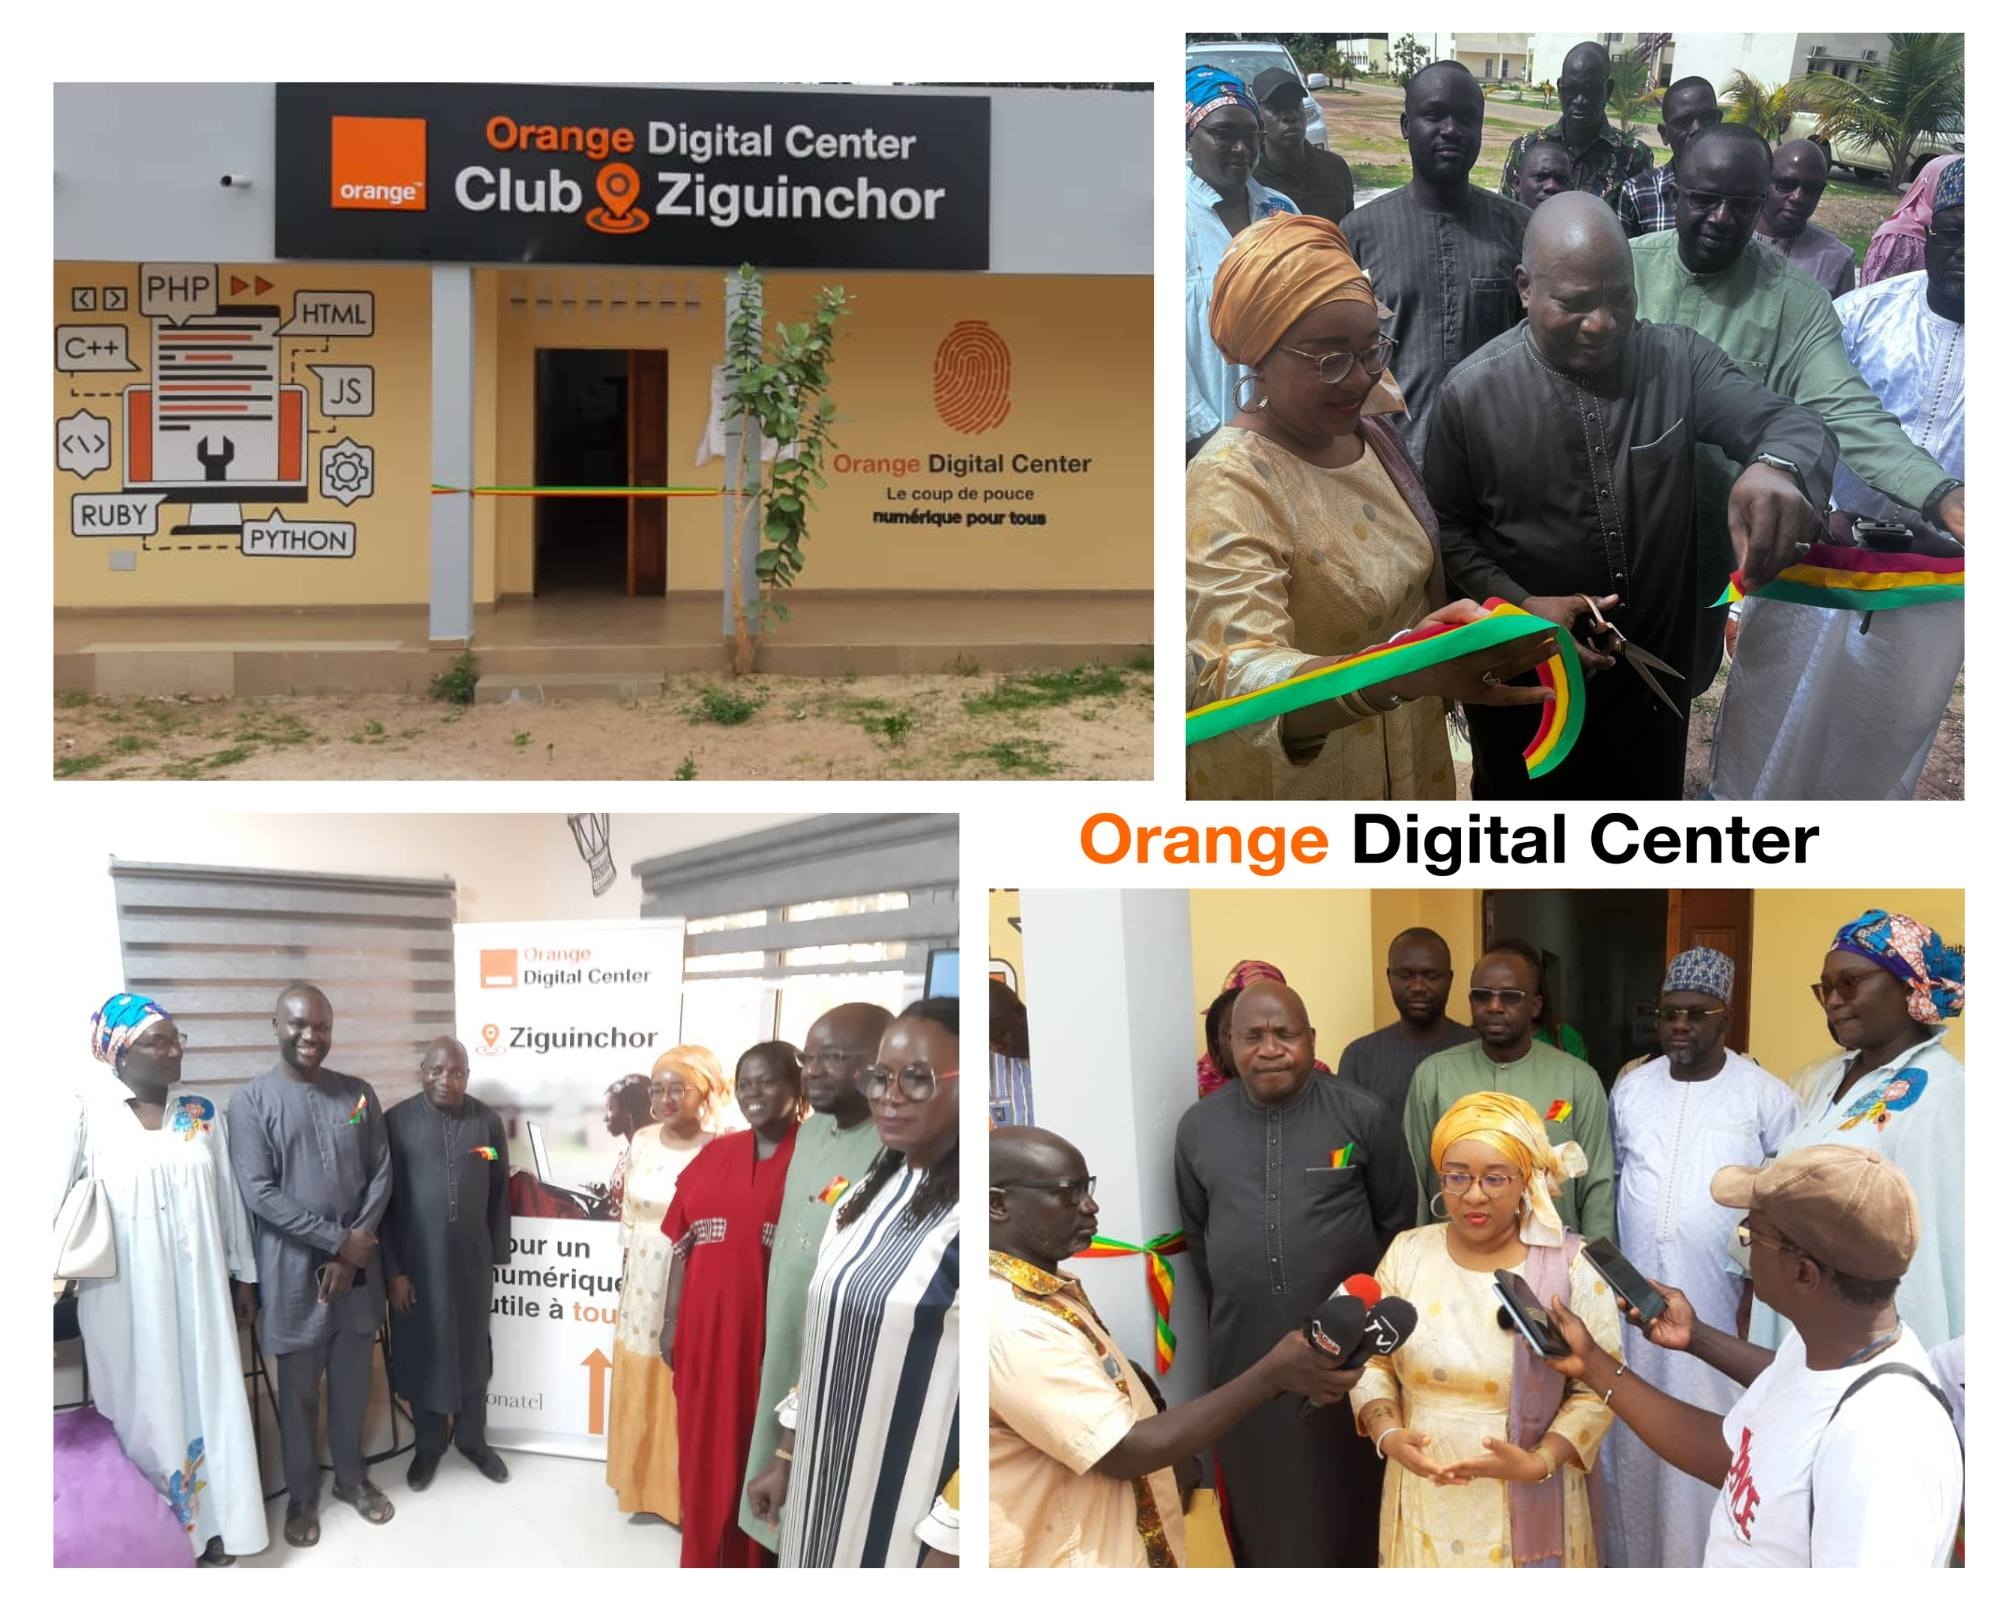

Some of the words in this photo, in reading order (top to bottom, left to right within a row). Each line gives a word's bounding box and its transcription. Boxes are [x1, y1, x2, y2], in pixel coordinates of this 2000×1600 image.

[486, 115, 635, 161] Orange
[648, 121, 772, 164] Digital
[785, 125, 917, 160] Center
[454, 165, 583, 214] Club
[655, 172, 946, 228] Ziguinchor
[148, 275, 210, 302] PHP
[302, 303, 367, 325] HTML
[64, 336, 119, 360] C++
[330, 377, 362, 405] JS
[833, 453, 921, 478] Orange
[928, 453, 1004, 478] Digital
[1011, 454, 1092, 474] Center
[886, 487, 907, 501] Le
[911, 489, 953, 503] coup
[958, 486, 979, 501] de
[983, 488, 1035, 504] pouce
[81, 503, 148, 526] RUBY
[872, 508, 963, 527] numérique
[966, 511, 1006, 527] pour
[1009, 511, 1047, 526] tous
[250, 529, 347, 551] PYTHON
[524, 947, 592, 965] Orange
[524, 968, 582, 989] Digital
[588, 968, 652, 985] Center
[509, 1026, 660, 1054] Ziguinchor
[510, 1237, 548, 1256] our
[557, 1240, 591, 1259] un
[549, 1298, 564, 1320] à
[572, 1301, 618, 1325] tou
[487, 1392, 543, 1411] onatel
